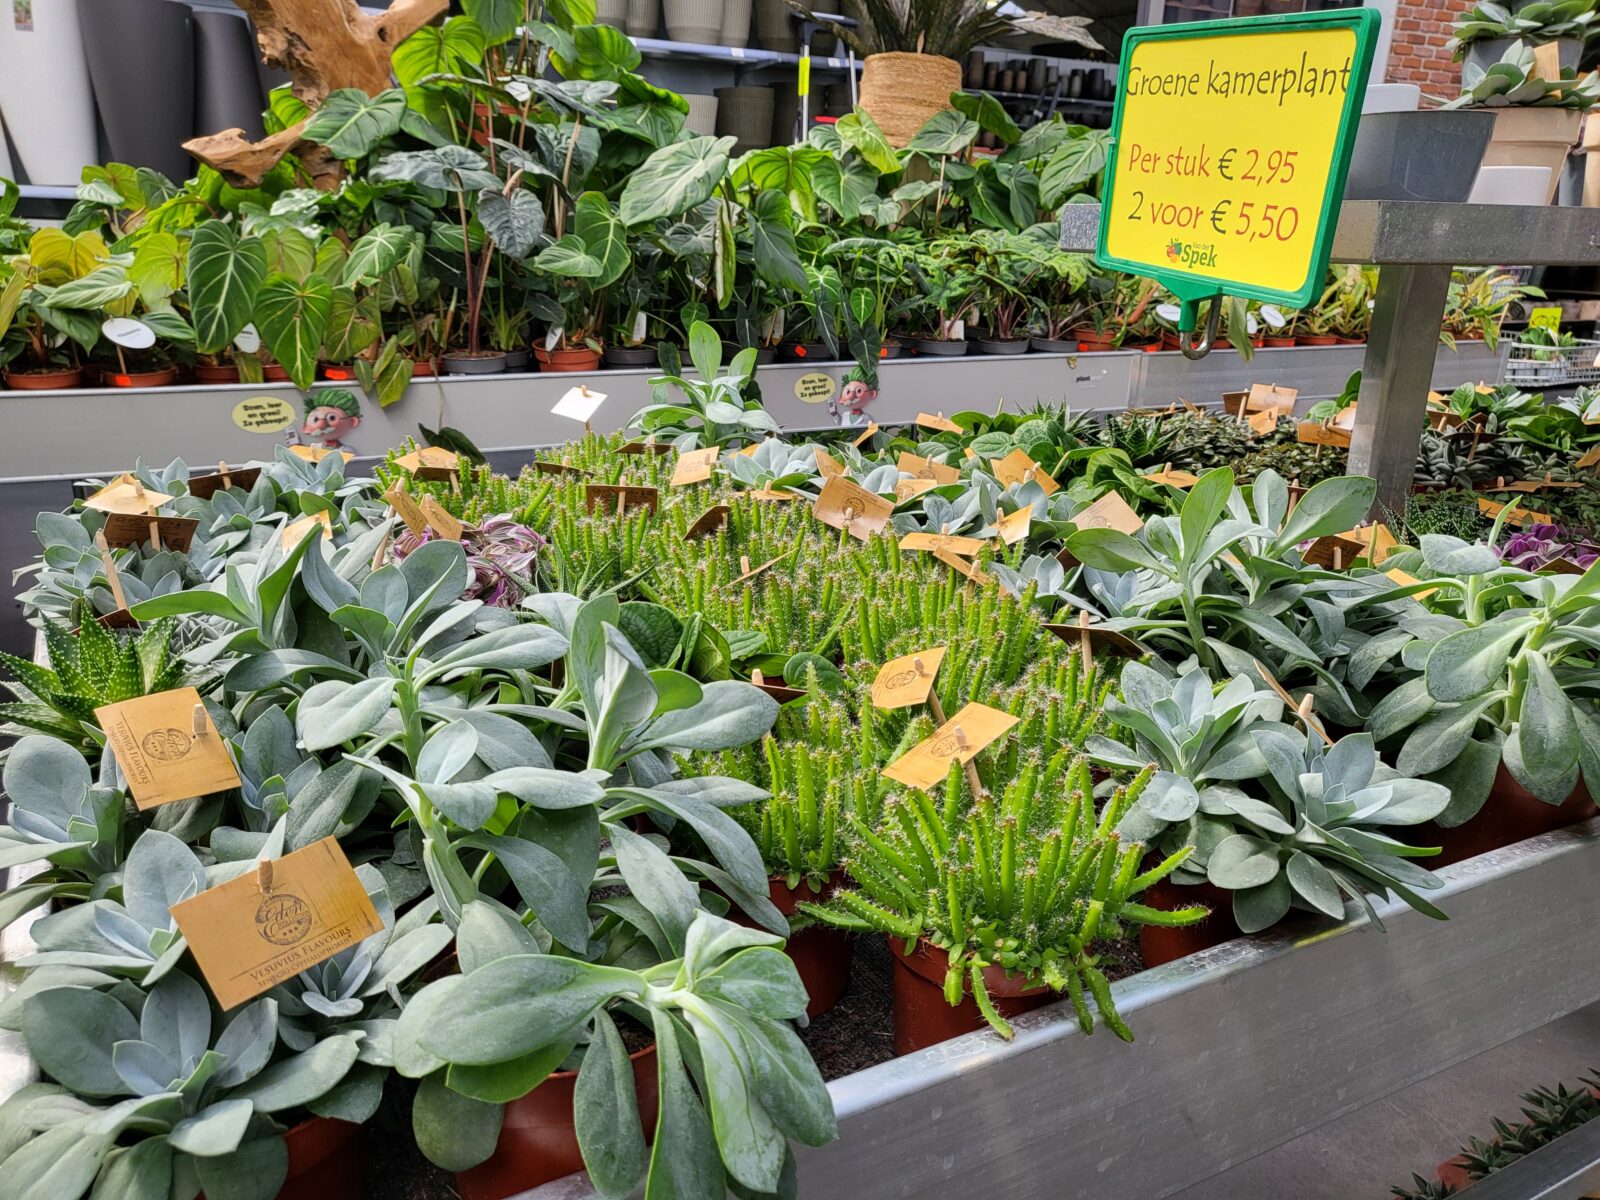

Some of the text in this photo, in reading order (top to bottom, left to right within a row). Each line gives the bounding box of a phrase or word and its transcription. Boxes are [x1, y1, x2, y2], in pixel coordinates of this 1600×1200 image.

[1126, 51, 1351, 107] Groene kamerplant
[1128, 143, 1298, 187] Per stuk € 2,95
[1128, 190, 1299, 242] 2 voor € 5,50
[1181, 244, 1217, 268] Spek
[250, 952, 301, 980] VESUVIUS
[302, 927, 351, 955] FLAVOURS
